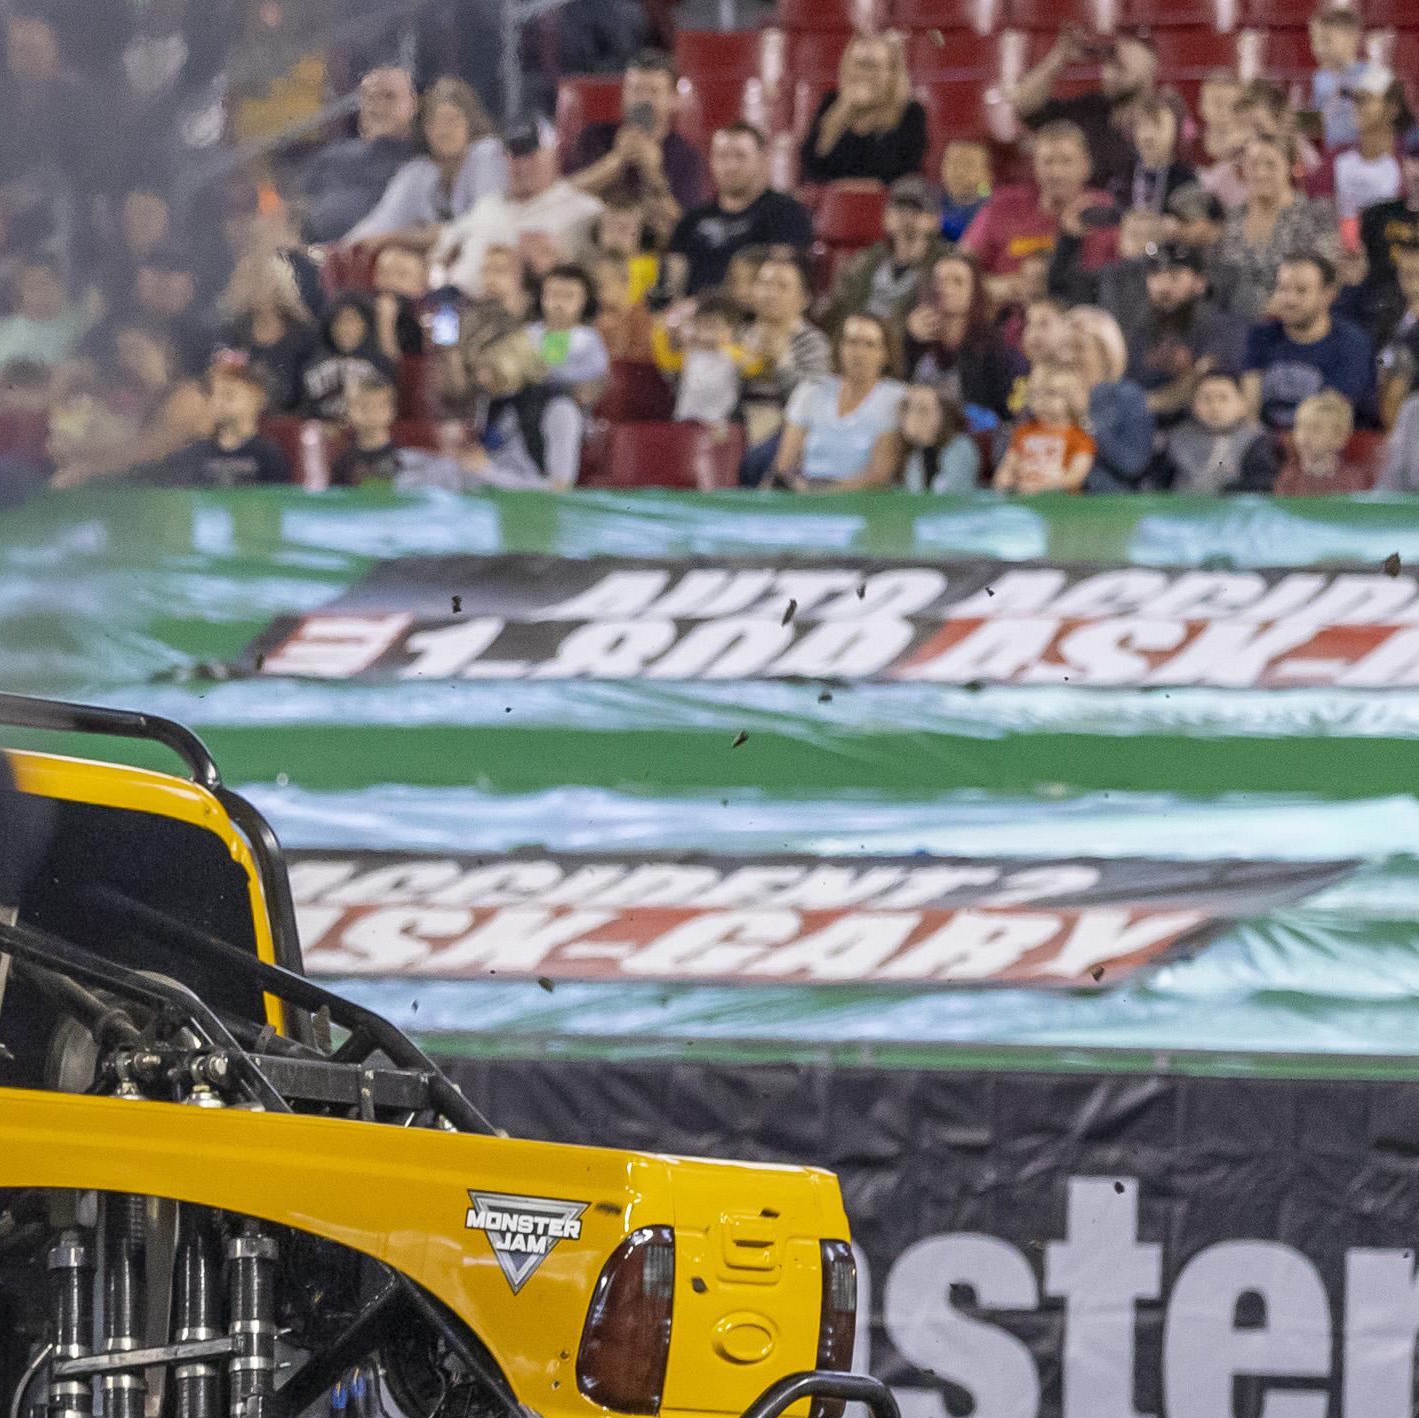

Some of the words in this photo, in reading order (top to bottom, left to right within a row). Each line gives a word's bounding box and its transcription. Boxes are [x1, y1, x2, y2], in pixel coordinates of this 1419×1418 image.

[528, 567, 947, 622] AUTO
[943, 567, 1419, 624] ACCID
[465, 1207, 583, 1241] MONSTER
[495, 1234, 548, 1256] JAM
